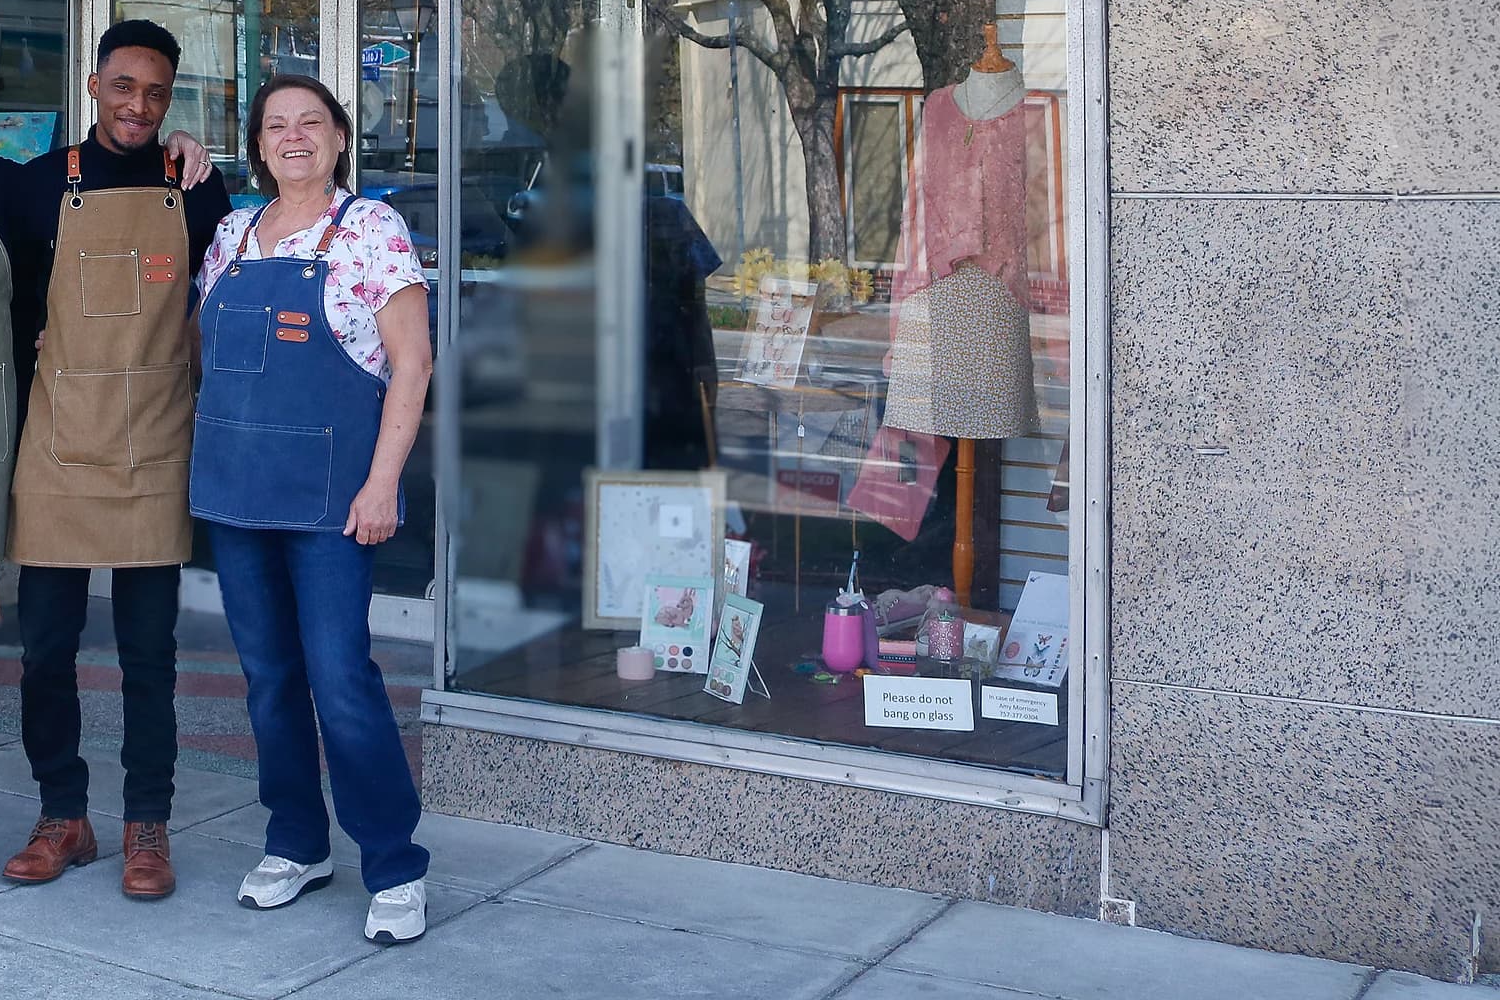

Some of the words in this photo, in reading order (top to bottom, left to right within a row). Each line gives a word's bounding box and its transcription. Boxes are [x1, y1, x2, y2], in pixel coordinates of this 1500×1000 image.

[882, 692, 916, 704] Please
[918, 693, 933, 704] do
[935, 695, 954, 705] not
[883, 708, 909, 721] bang
[913, 712, 926, 720] on
[928, 709, 954, 722] glass
